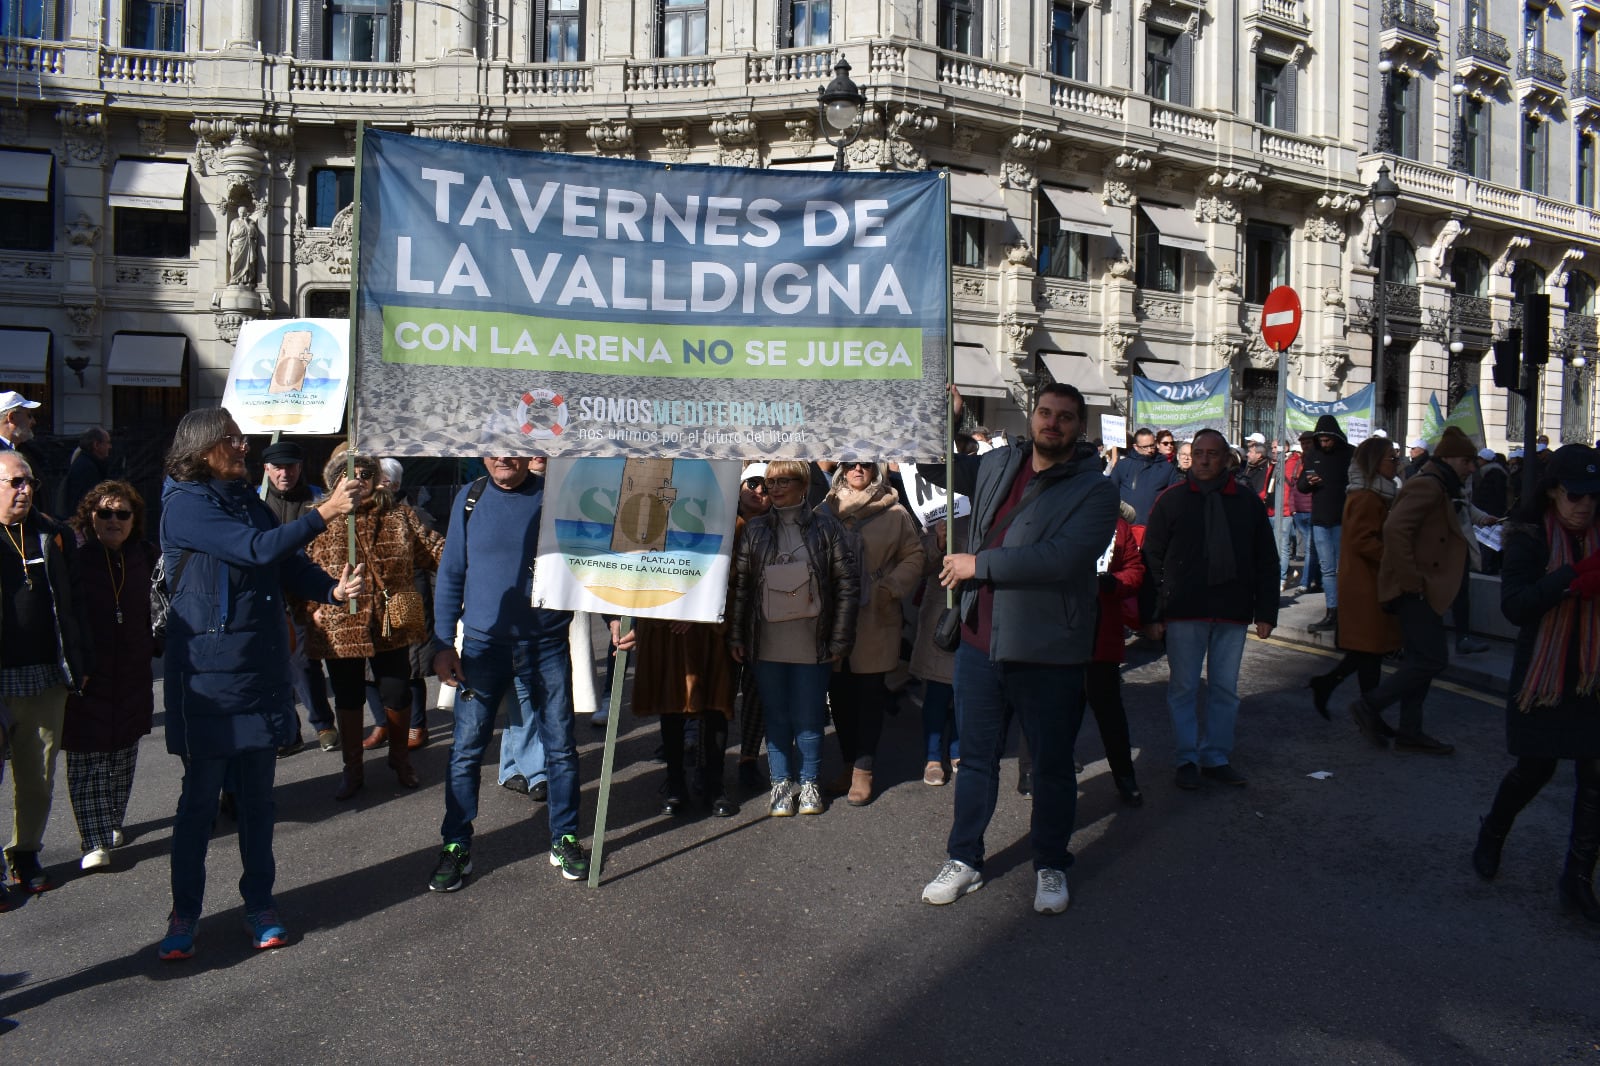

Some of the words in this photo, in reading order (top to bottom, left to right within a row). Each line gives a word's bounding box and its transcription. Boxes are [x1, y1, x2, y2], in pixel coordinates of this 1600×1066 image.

[421, 167, 783, 248] TAVERNES
[803, 199, 889, 248] DE
[396, 236, 492, 297] LA
[510, 248, 913, 315] VALLDIGNA
[394, 321, 477, 353] CON
[490, 326, 539, 356] LA
[548, 332, 673, 364] ARENA
[683, 339, 734, 365] NO
[745, 340, 787, 366] SE
[797, 340, 912, 367] JUEGA
[1155, 382, 1210, 400] OLIVA
[579, 427, 603, 440] nos
[609, 428, 658, 443] unimos
[662, 431, 683, 446] por
[688, 429, 699, 443] el
[703, 429, 742, 444] futuro
[746, 429, 765, 443] del
[769, 429, 805, 443] litoral
[575, 486, 708, 549] SOS
[569, 558, 618, 570] TAVERNES
[620, 563, 633, 571] DE
[635, 565, 648, 573] LA
[650, 566, 702, 577] VALLDIGNA
[641, 555, 676, 565] PLATJA
[679, 559, 691, 567] DE
